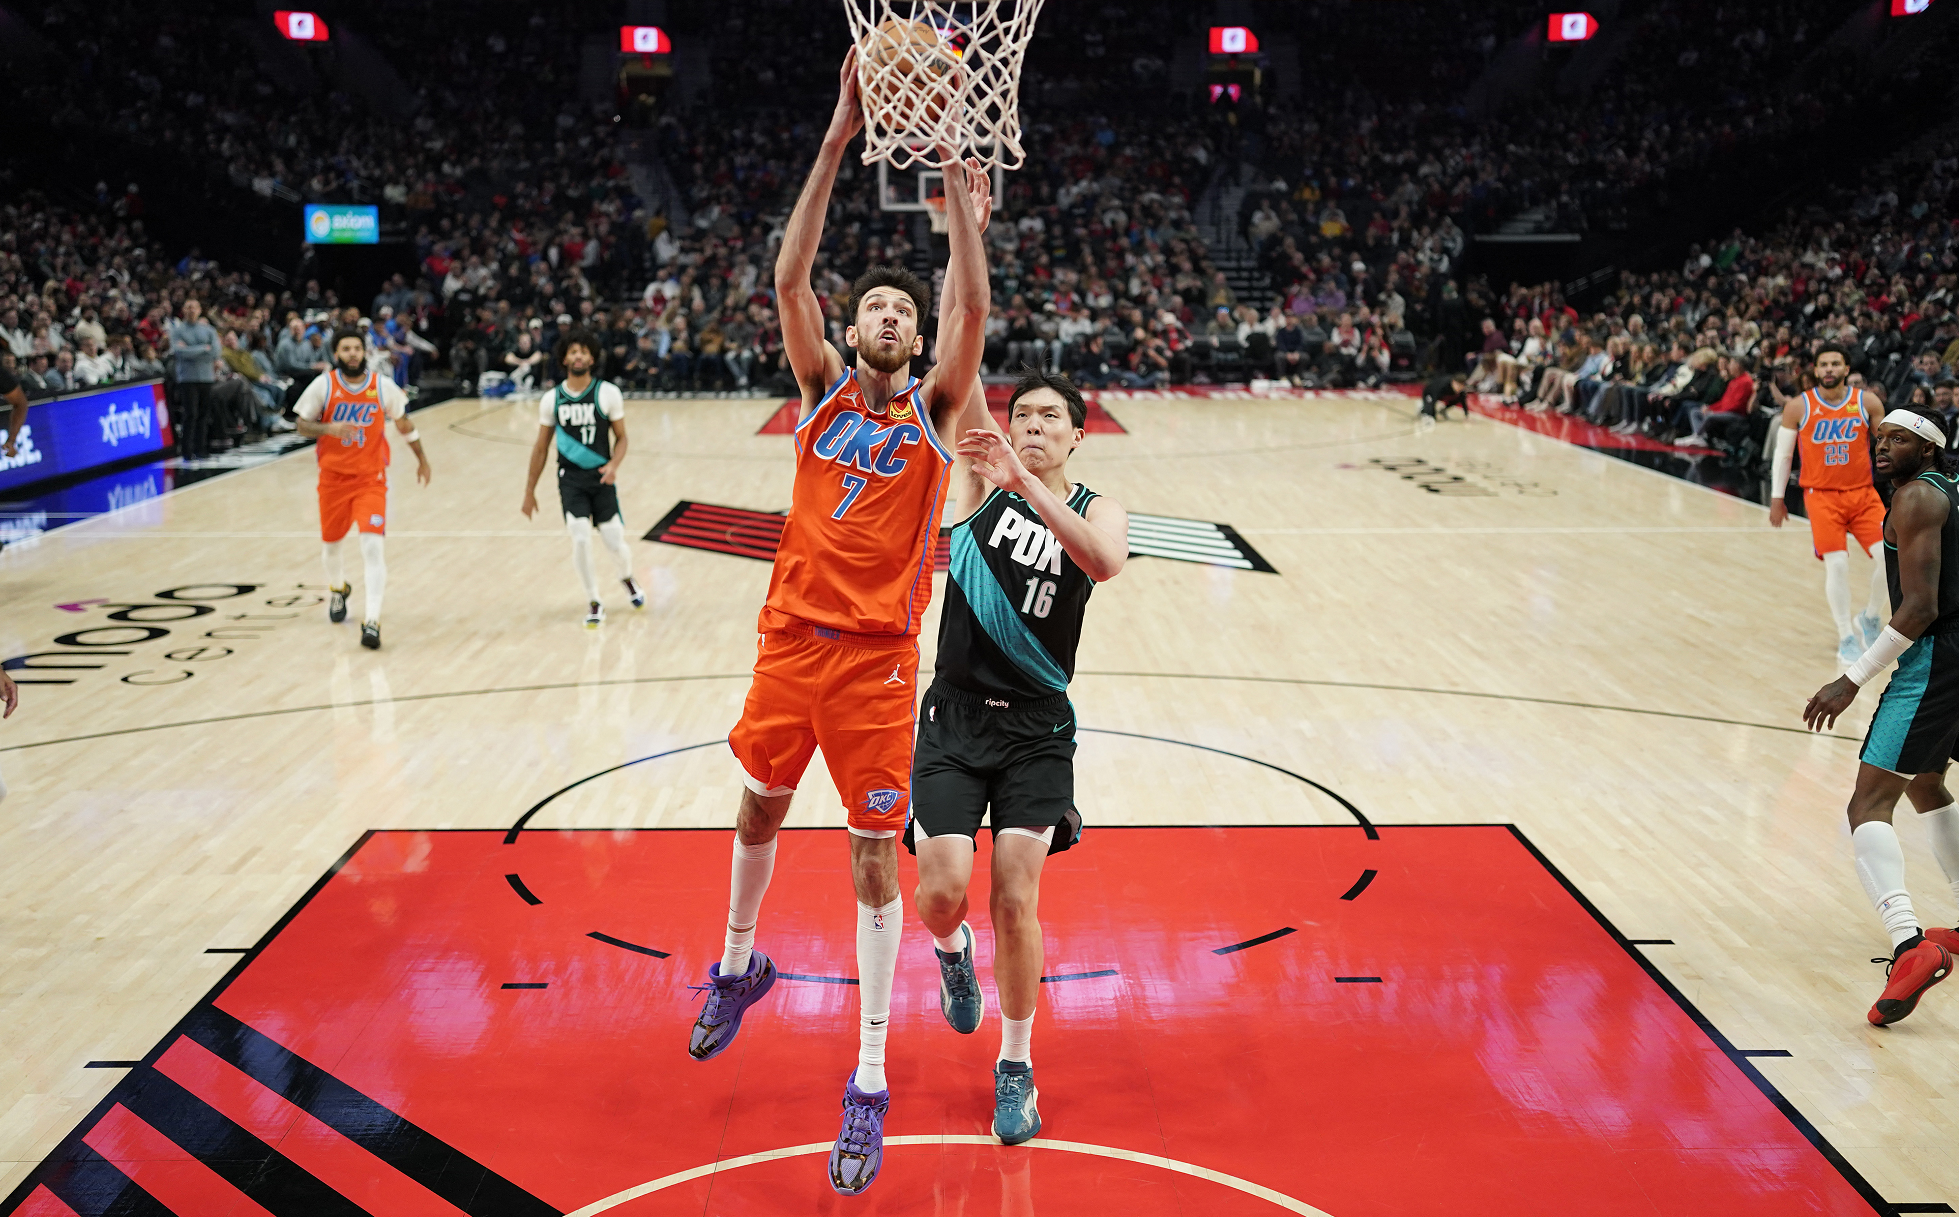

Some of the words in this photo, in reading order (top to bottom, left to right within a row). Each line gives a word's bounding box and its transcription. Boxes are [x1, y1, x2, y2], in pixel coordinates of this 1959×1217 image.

[99, 401, 151, 447] xfinity
[331, 401, 378, 427] OKC
[558, 402, 597, 427] PDX
[1811, 417, 1862, 444] OKC
[580, 425, 597, 446] 17
[813, 410, 922, 477] OKC
[1824, 443, 1850, 466] 25
[831, 472, 867, 520] 7
[988, 506, 1064, 576] PDX
[1021, 576, 1057, 619] 16
[1, 583, 266, 685] moda
[120, 582, 333, 686] center
[985, 698, 1010, 709] ripcity
[869, 793, 892, 808] OKC
